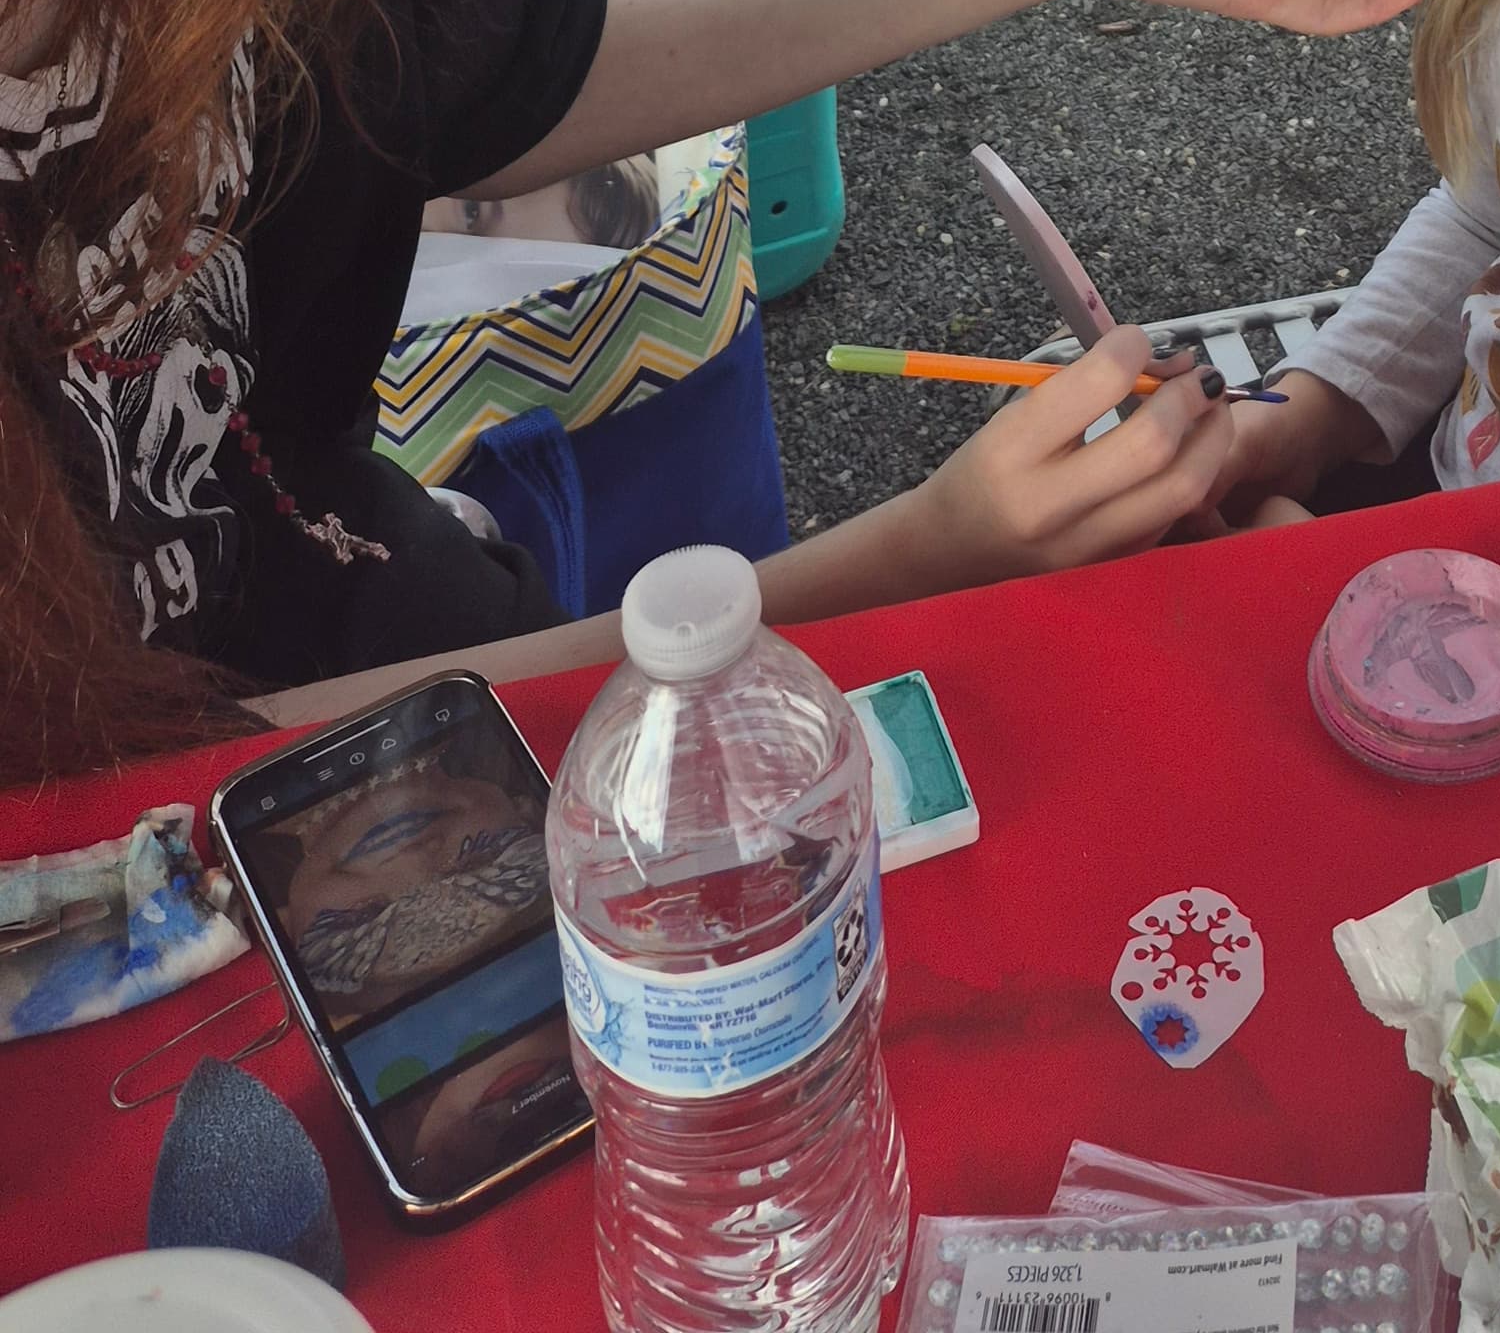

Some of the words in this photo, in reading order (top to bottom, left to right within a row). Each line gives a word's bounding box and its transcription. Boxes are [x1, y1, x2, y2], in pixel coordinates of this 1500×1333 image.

[645, 1011, 712, 1023] DISTRIBUTED
[735, 991, 783, 1016] Wal-Mart
[648, 1037, 692, 1050] PURIFIED
[520, 1074, 571, 1109] November
[511, 1104, 519, 1114] 7
[1229, 1260, 1238, 1271] at
[1240, 1255, 1262, 1268] more
[1264, 1253, 1282, 1266] Find
[1007, 1265, 1049, 1282] PIECES
[1052, 1263, 1083, 1282] 1,326
[1168, 1261, 1227, 1274] Walmart.com
[1000, 1292, 1040, 1303] 23111
[1046, 1292, 1084, 1304] 10096
